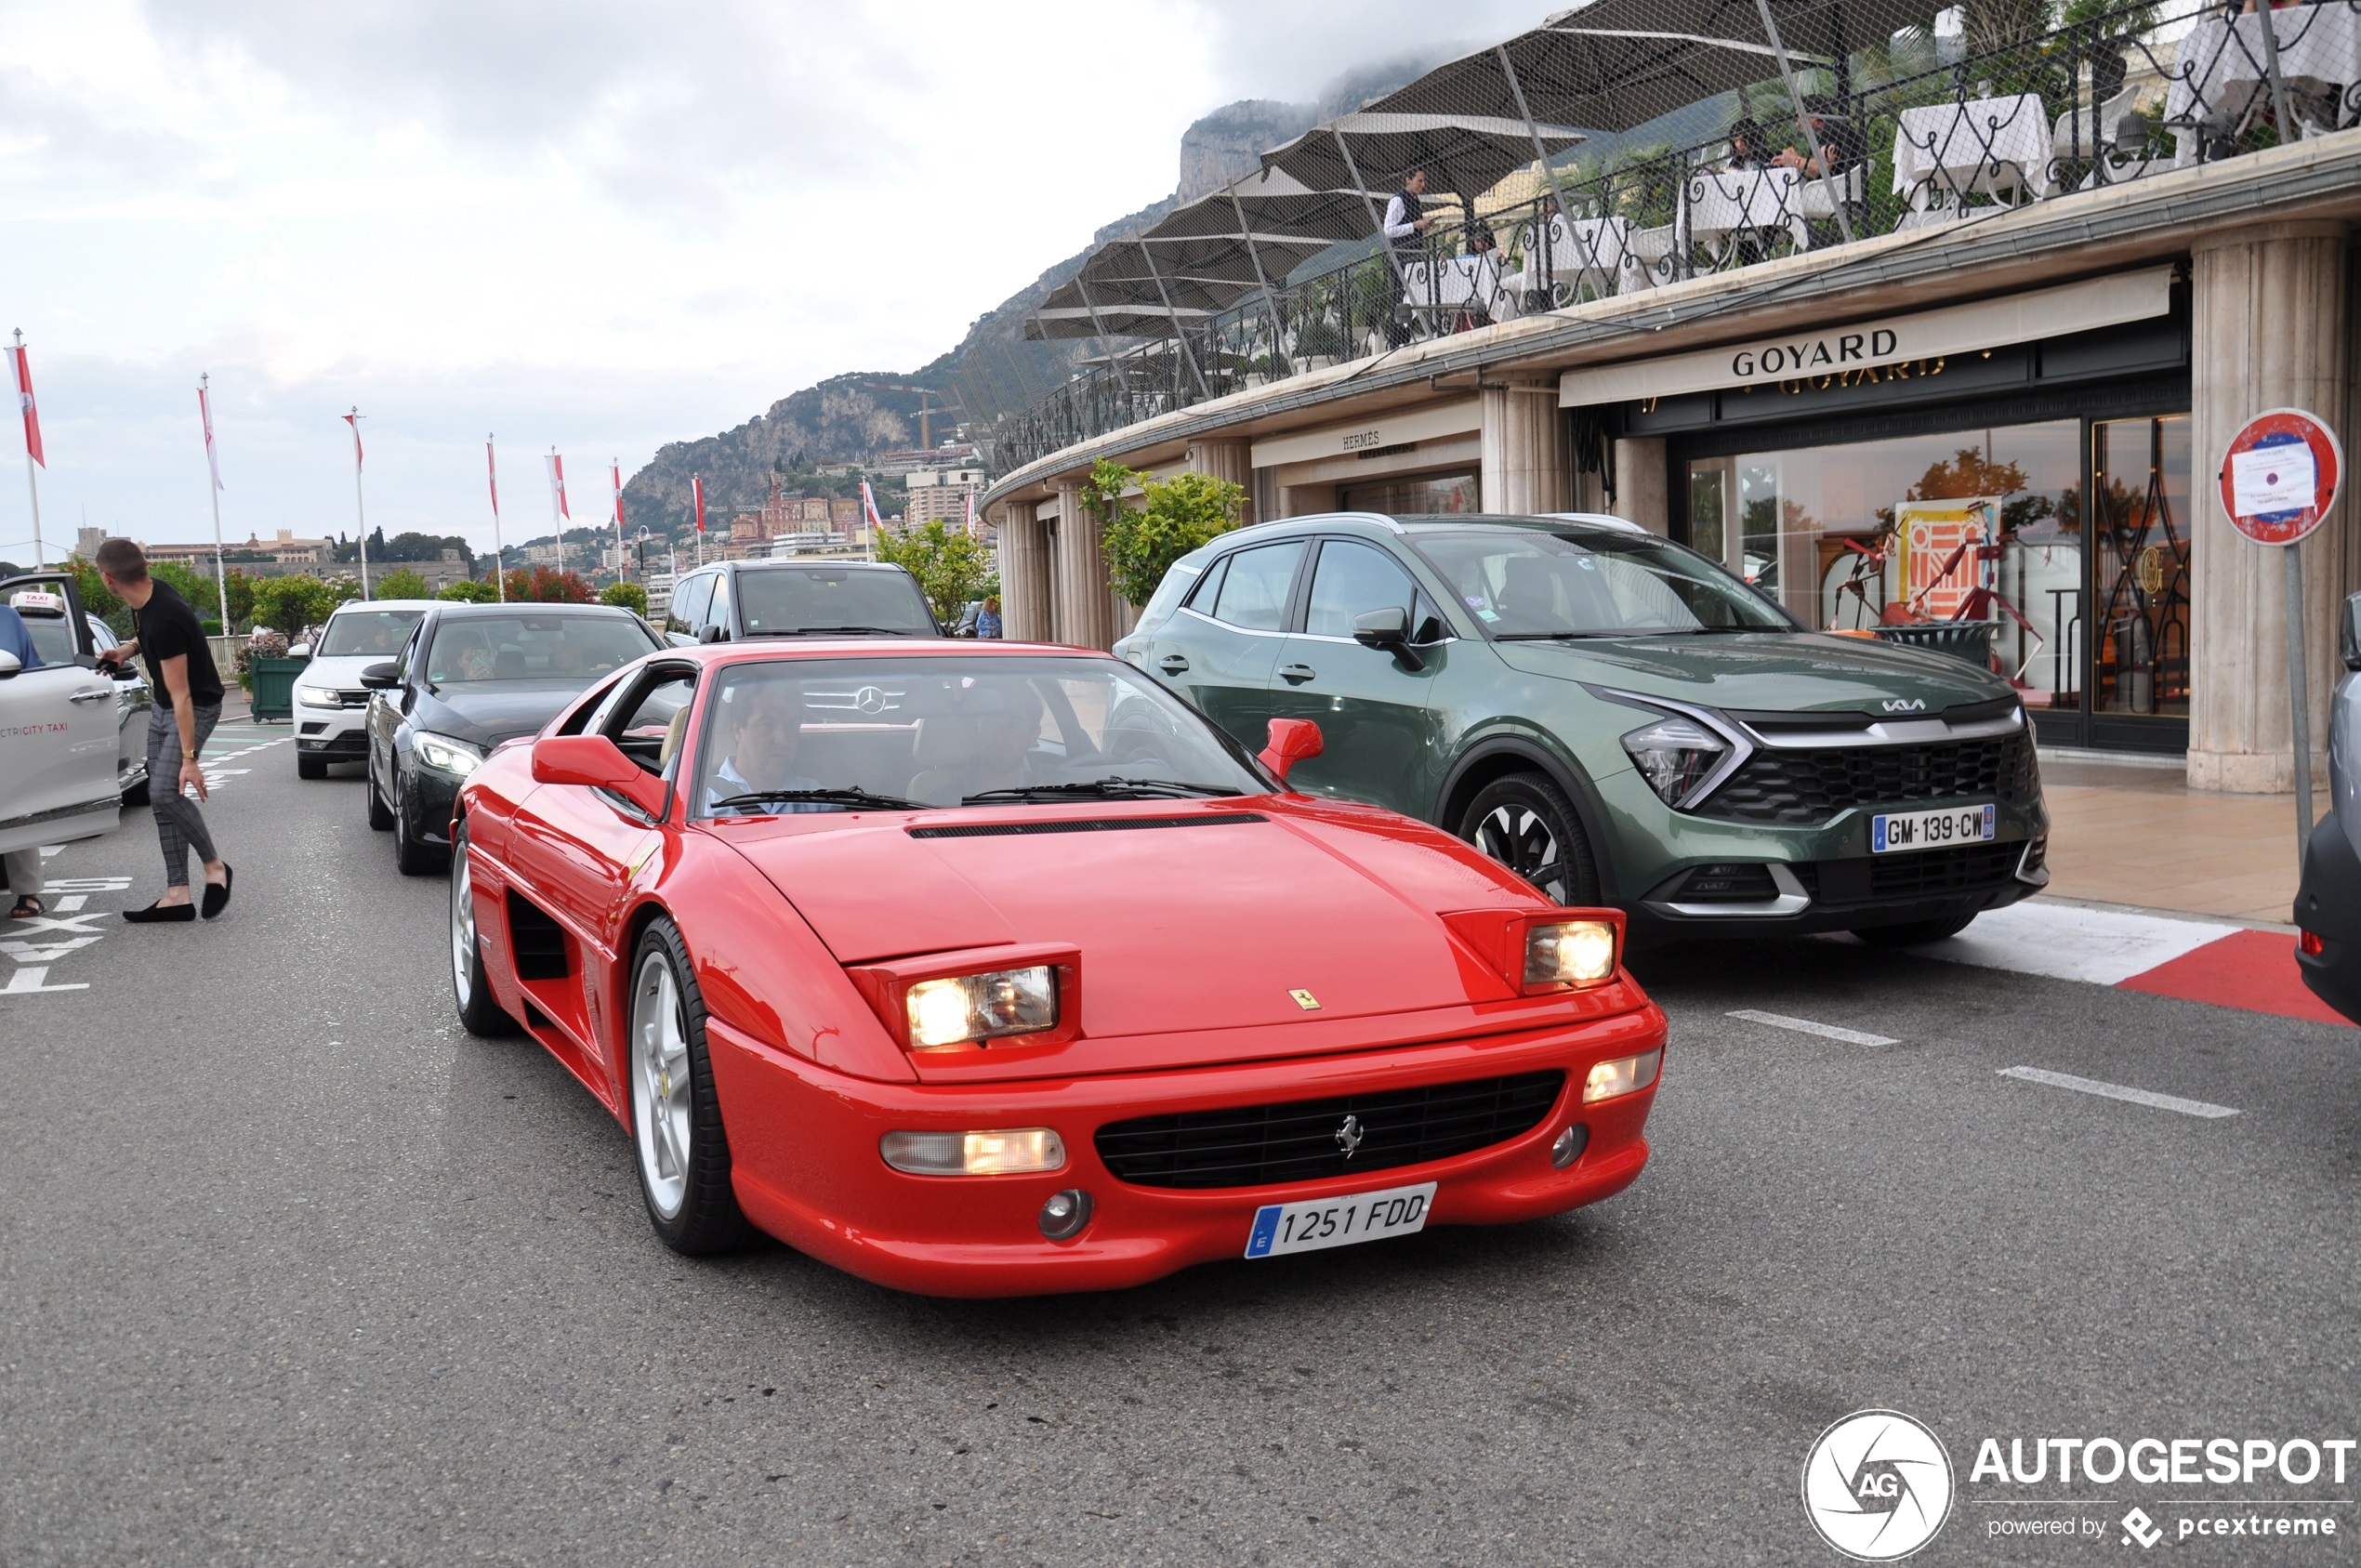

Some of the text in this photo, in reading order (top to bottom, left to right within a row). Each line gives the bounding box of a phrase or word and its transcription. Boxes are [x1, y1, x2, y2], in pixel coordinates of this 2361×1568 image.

[1732, 328, 1898, 377] GOYARD
[1882, 698, 1927, 712] KIA
[47, 722, 68, 732] TAXI
[1877, 837, 1882, 846] F
[1256, 1194, 1426, 1248] E 1251 FDD
